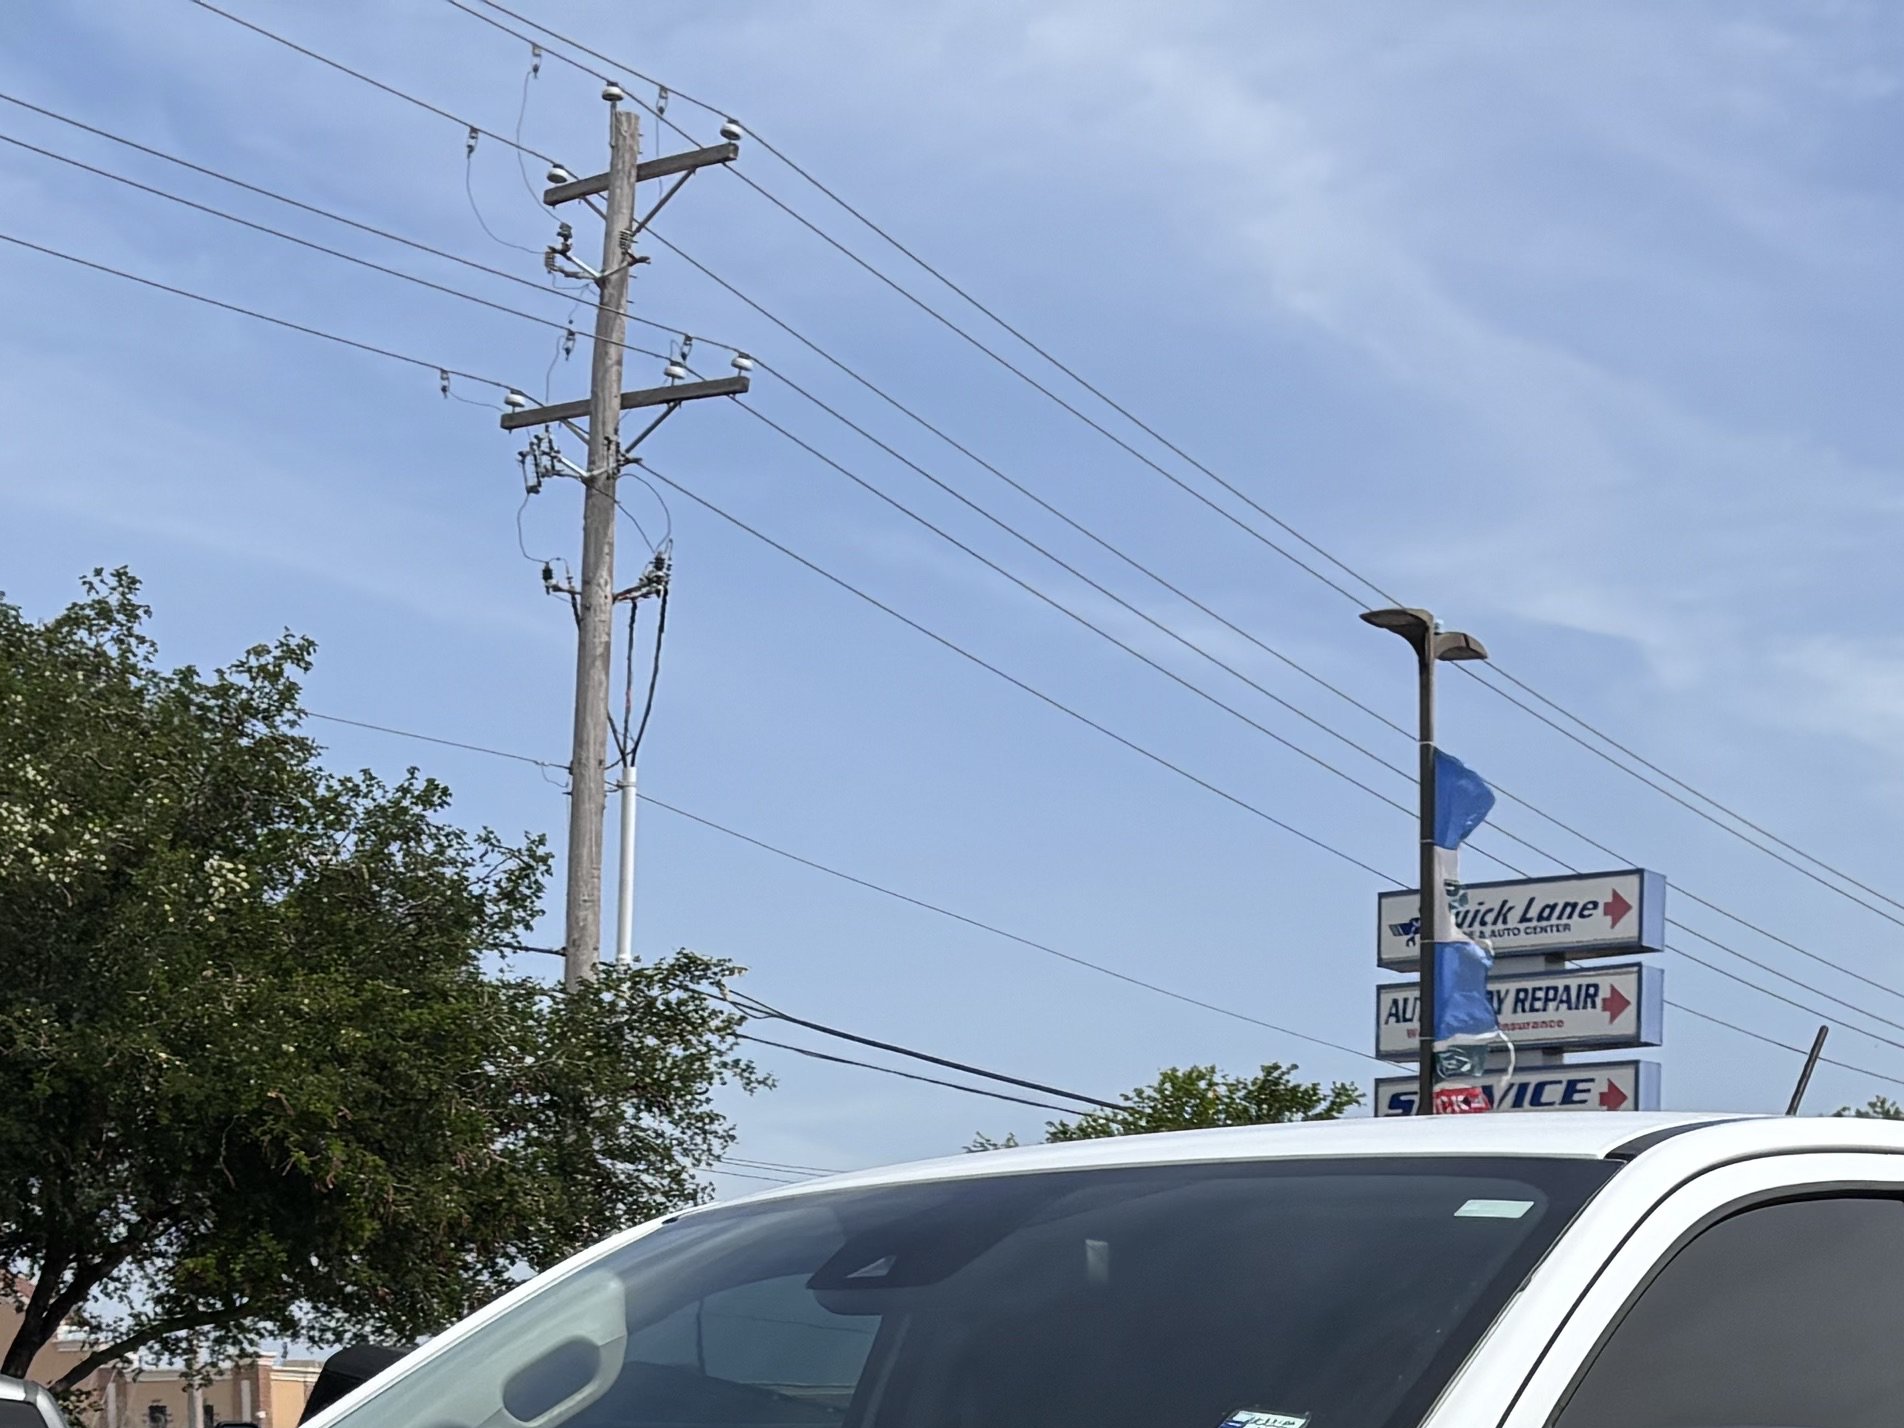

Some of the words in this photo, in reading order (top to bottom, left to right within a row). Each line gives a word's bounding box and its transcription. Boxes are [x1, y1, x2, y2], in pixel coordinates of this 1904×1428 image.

[1453, 899, 1516, 928] uick
[1517, 896, 1600, 925] Lane
[1489, 928, 1522, 939] AUTO
[1524, 922, 1572, 937] CENTER
[1511, 983, 1601, 1015] REPAIR
[1386, 1077, 1596, 1116] SVICE
